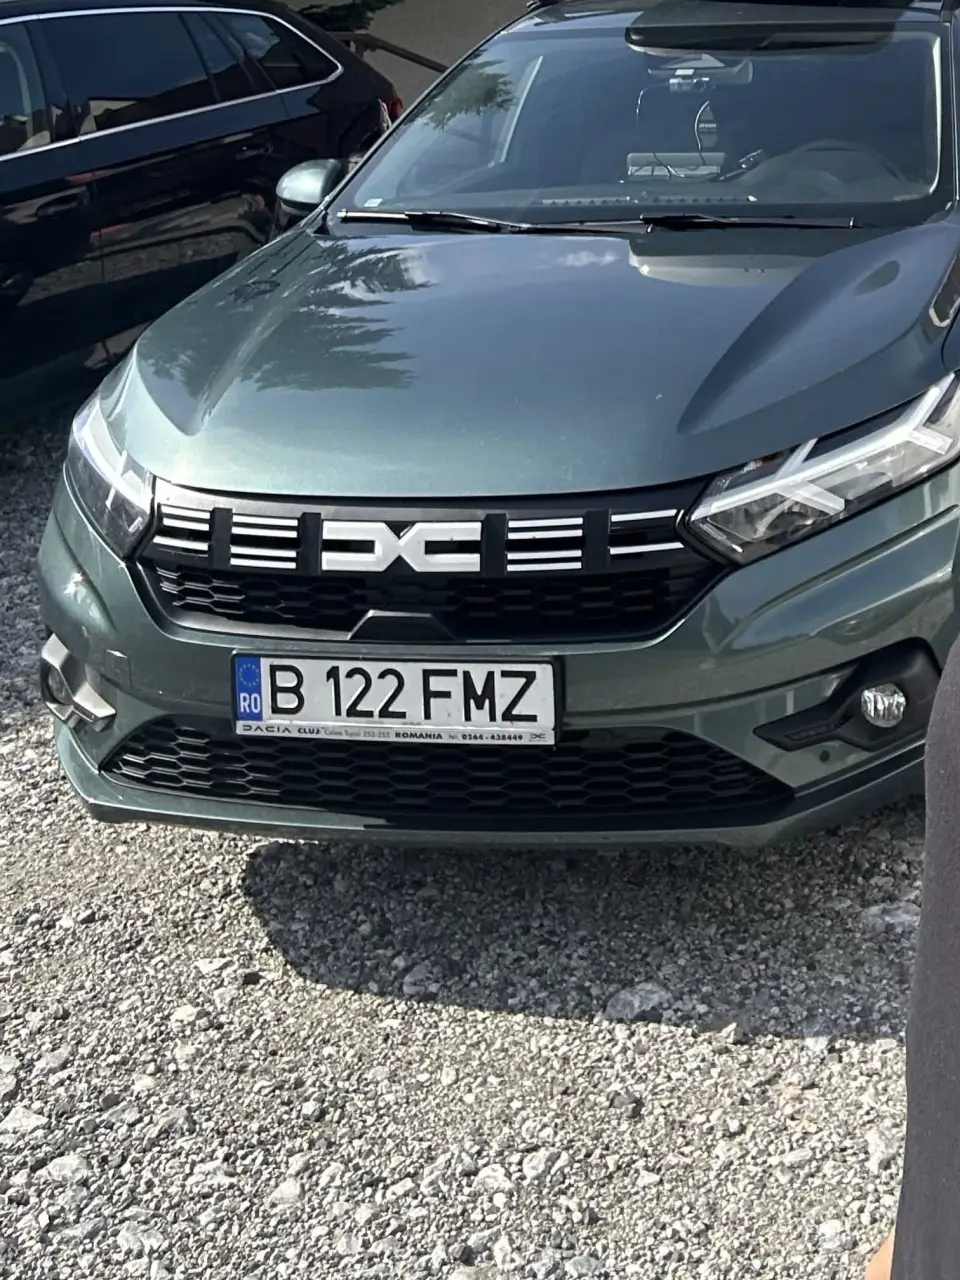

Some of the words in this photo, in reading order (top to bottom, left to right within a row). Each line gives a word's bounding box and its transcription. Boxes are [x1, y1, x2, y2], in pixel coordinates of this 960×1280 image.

[239, 692, 261, 714] RO
[269, 664, 305, 715] B
[326, 665, 407, 719] 122
[422, 668, 538, 722] FMZ
[242, 724, 292, 734] DACIA
[395, 732, 443, 740] ROMANIA
